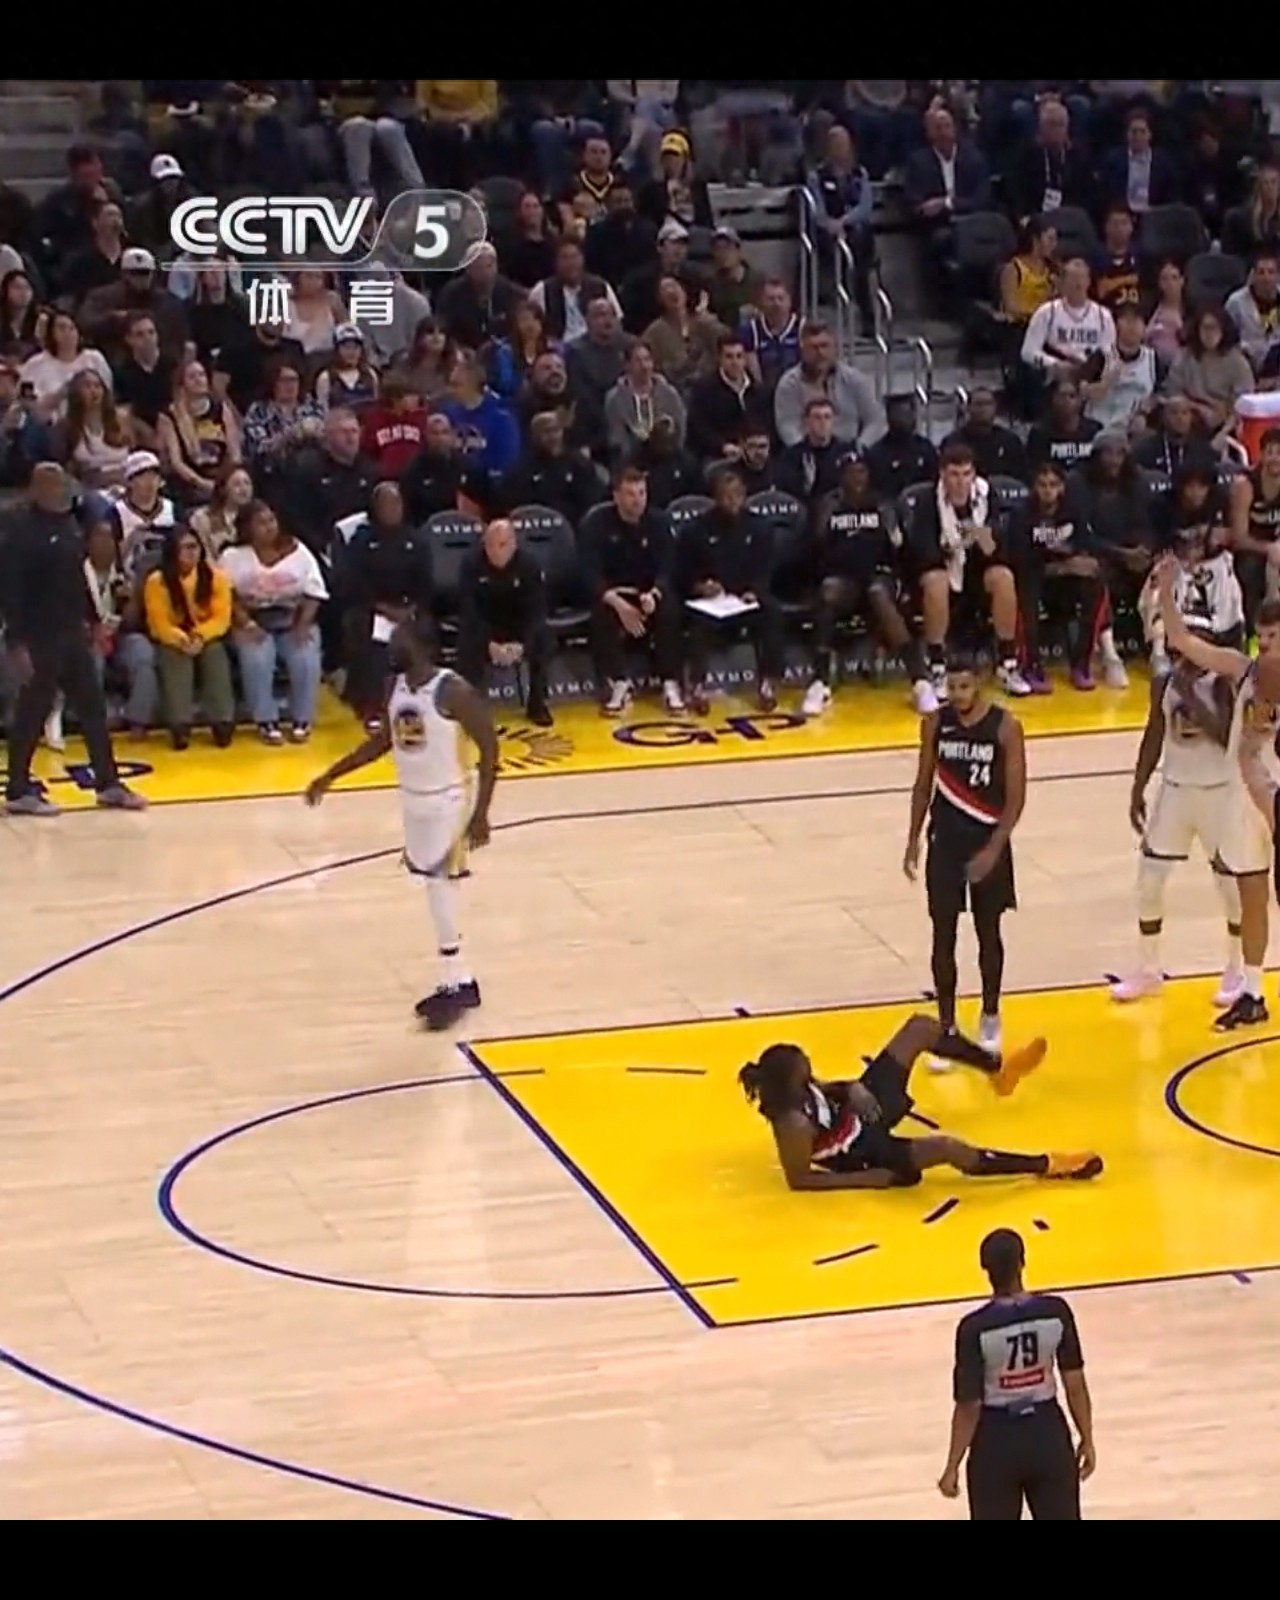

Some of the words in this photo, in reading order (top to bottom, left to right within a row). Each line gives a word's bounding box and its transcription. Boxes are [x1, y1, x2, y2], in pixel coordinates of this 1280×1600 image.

[1050, 441, 1094, 460] PORTLAN
[938, 740, 995, 763] PORTLAND
[968, 762, 992, 787] 24
[1006, 1331, 1039, 1372] 79
